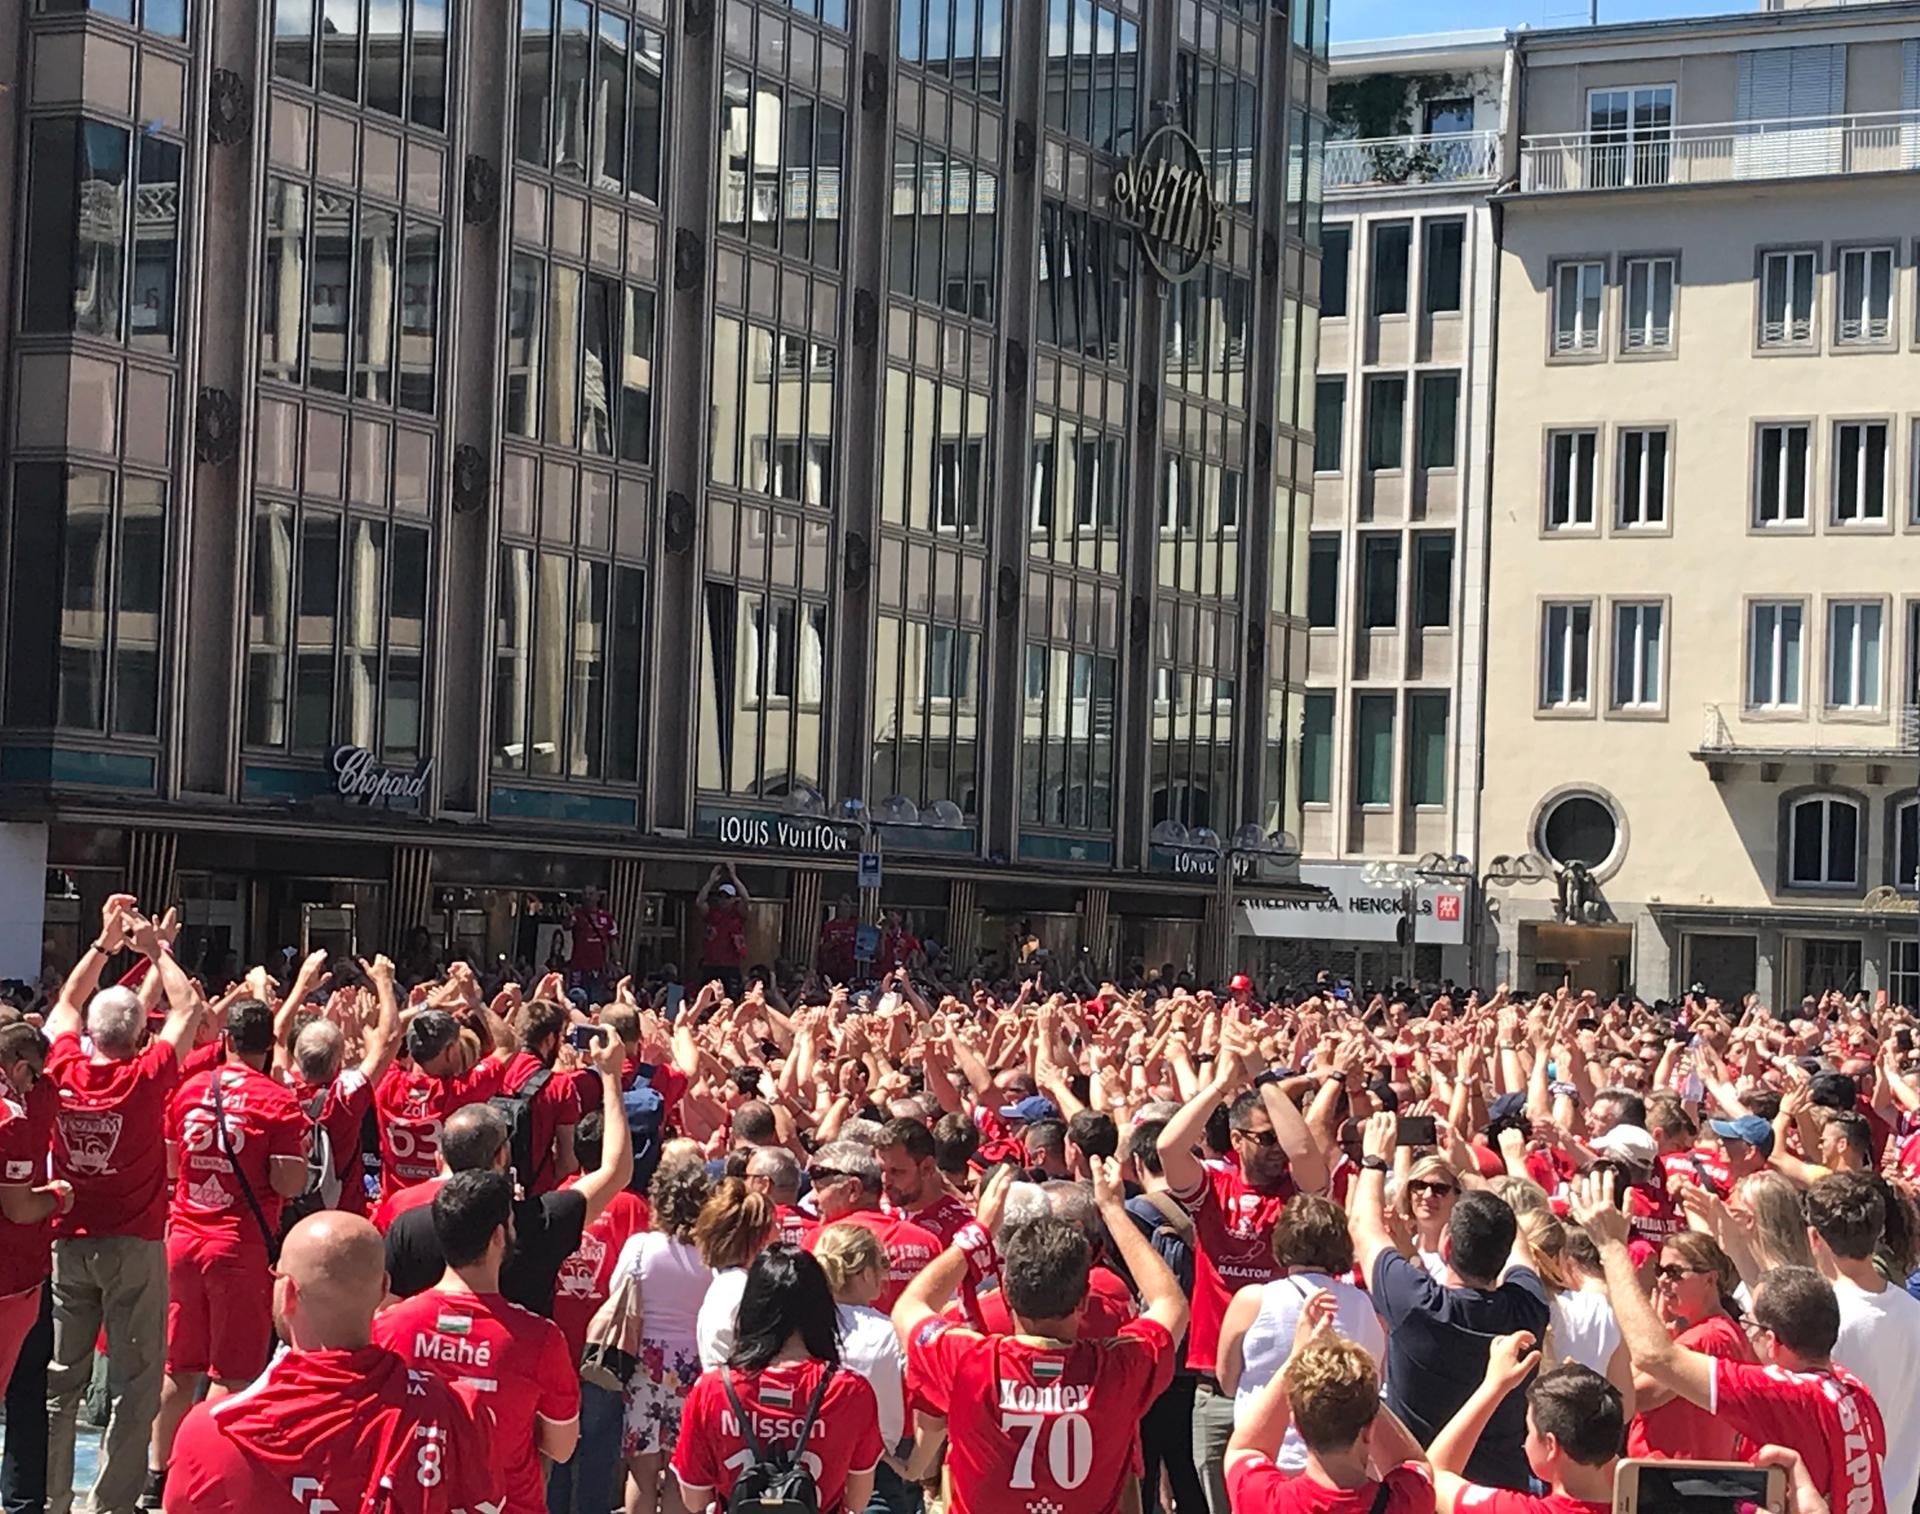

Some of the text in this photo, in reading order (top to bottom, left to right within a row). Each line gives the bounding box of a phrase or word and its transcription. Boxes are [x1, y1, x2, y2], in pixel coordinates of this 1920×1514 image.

[1149, 158, 1203, 250] 4711
[333, 745, 434, 806] Chopard
[720, 815, 769, 846] LOUIS
[1348, 897, 1433, 915] HENCKS
[1218, 1265, 1272, 1278] BALATON
[414, 1333, 491, 1367] Mahé
[999, 1379, 1094, 1413] Konter
[721, 1409, 826, 1439] Nlsson
[1001, 1412, 1093, 1490] 70
